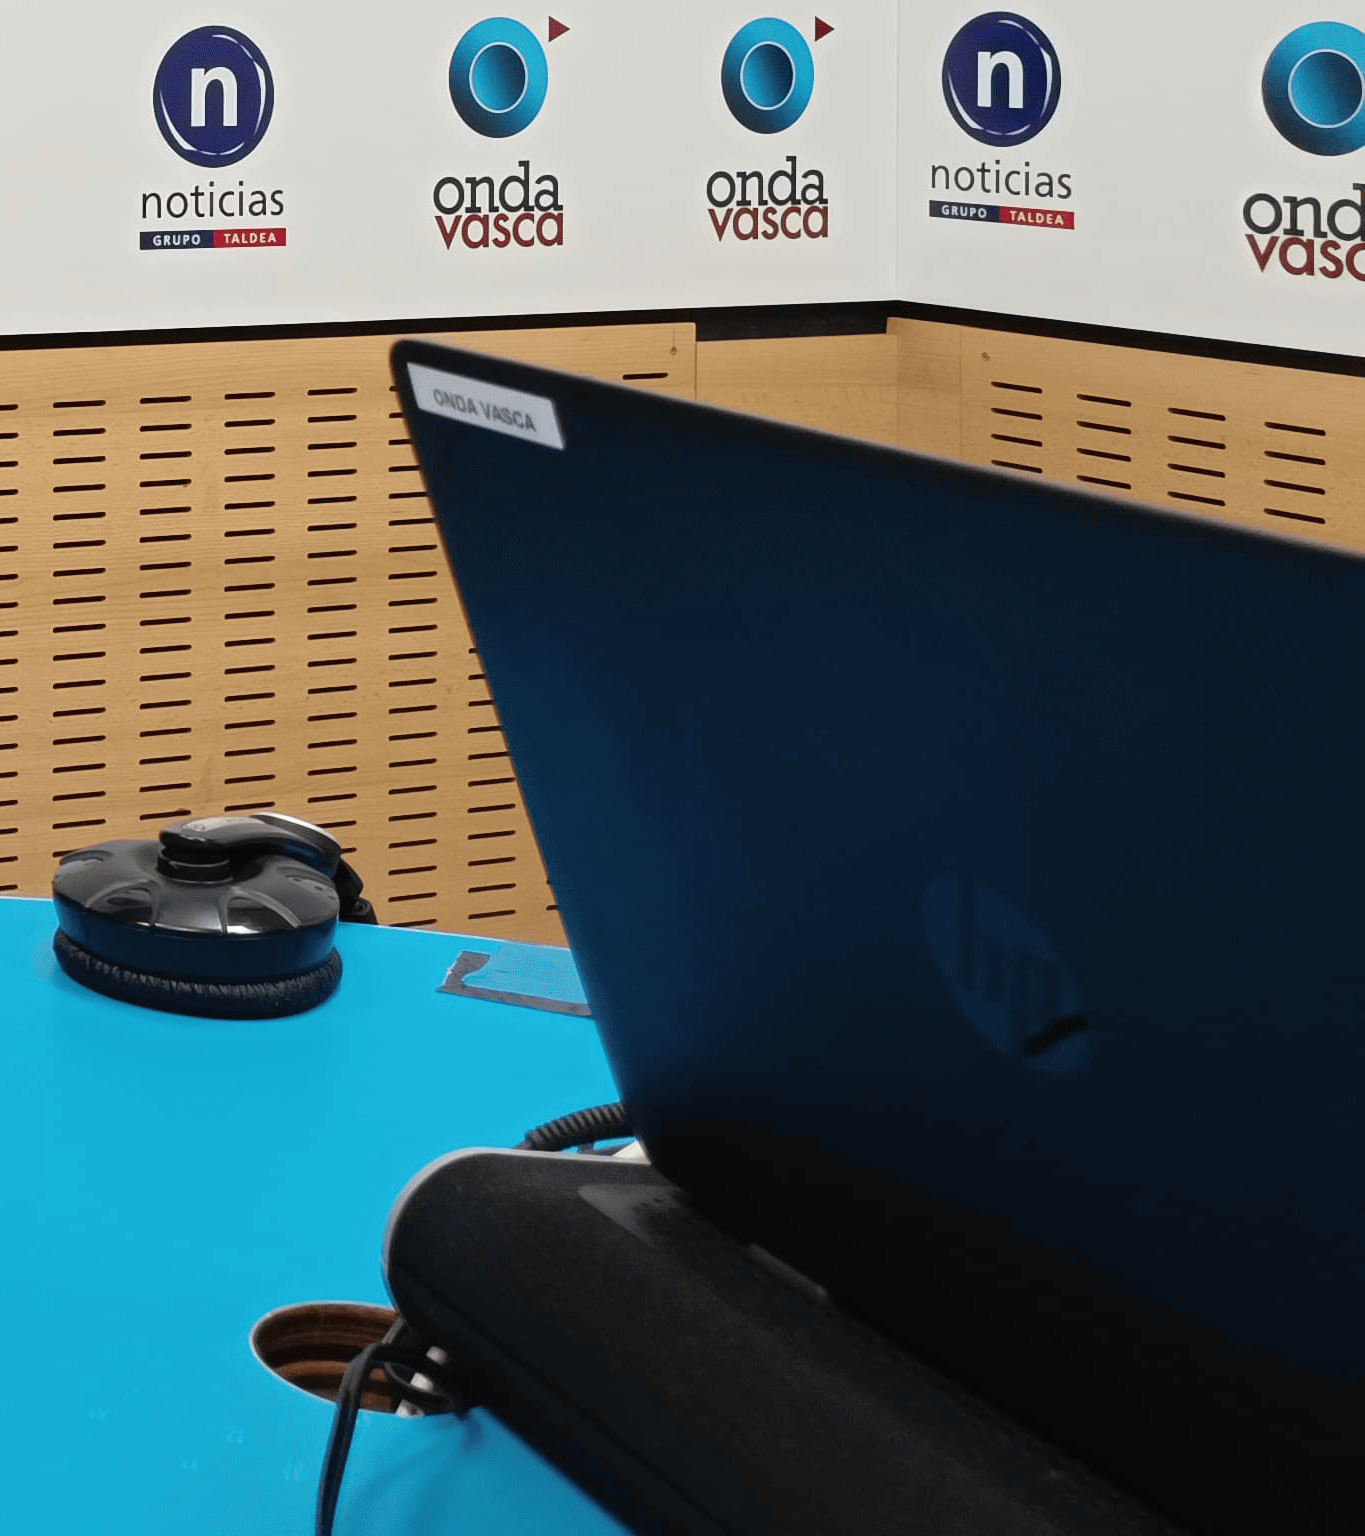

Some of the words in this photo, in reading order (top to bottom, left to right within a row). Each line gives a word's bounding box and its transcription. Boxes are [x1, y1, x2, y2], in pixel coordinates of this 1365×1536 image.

[190, 65, 238, 127] n
[977, 50, 1024, 109] n
[142, 180, 284, 219] noticias
[433, 159, 564, 216] onda
[706, 155, 829, 207] onda
[928, 159, 1072, 203] noticias
[435, 211, 564, 251] vasca
[708, 205, 829, 242] vasca
[941, 204, 988, 219] GRUPO
[1009, 210, 1065, 226] TALDEA
[1242, 182, 1365, 242] ond
[152, 234, 202, 246] GRUPO
[223, 231, 277, 244] TALDEA
[1245, 233, 1365, 282] vasc
[432, 388, 478, 415] ONDA
[479, 400, 536, 431] VASCA
